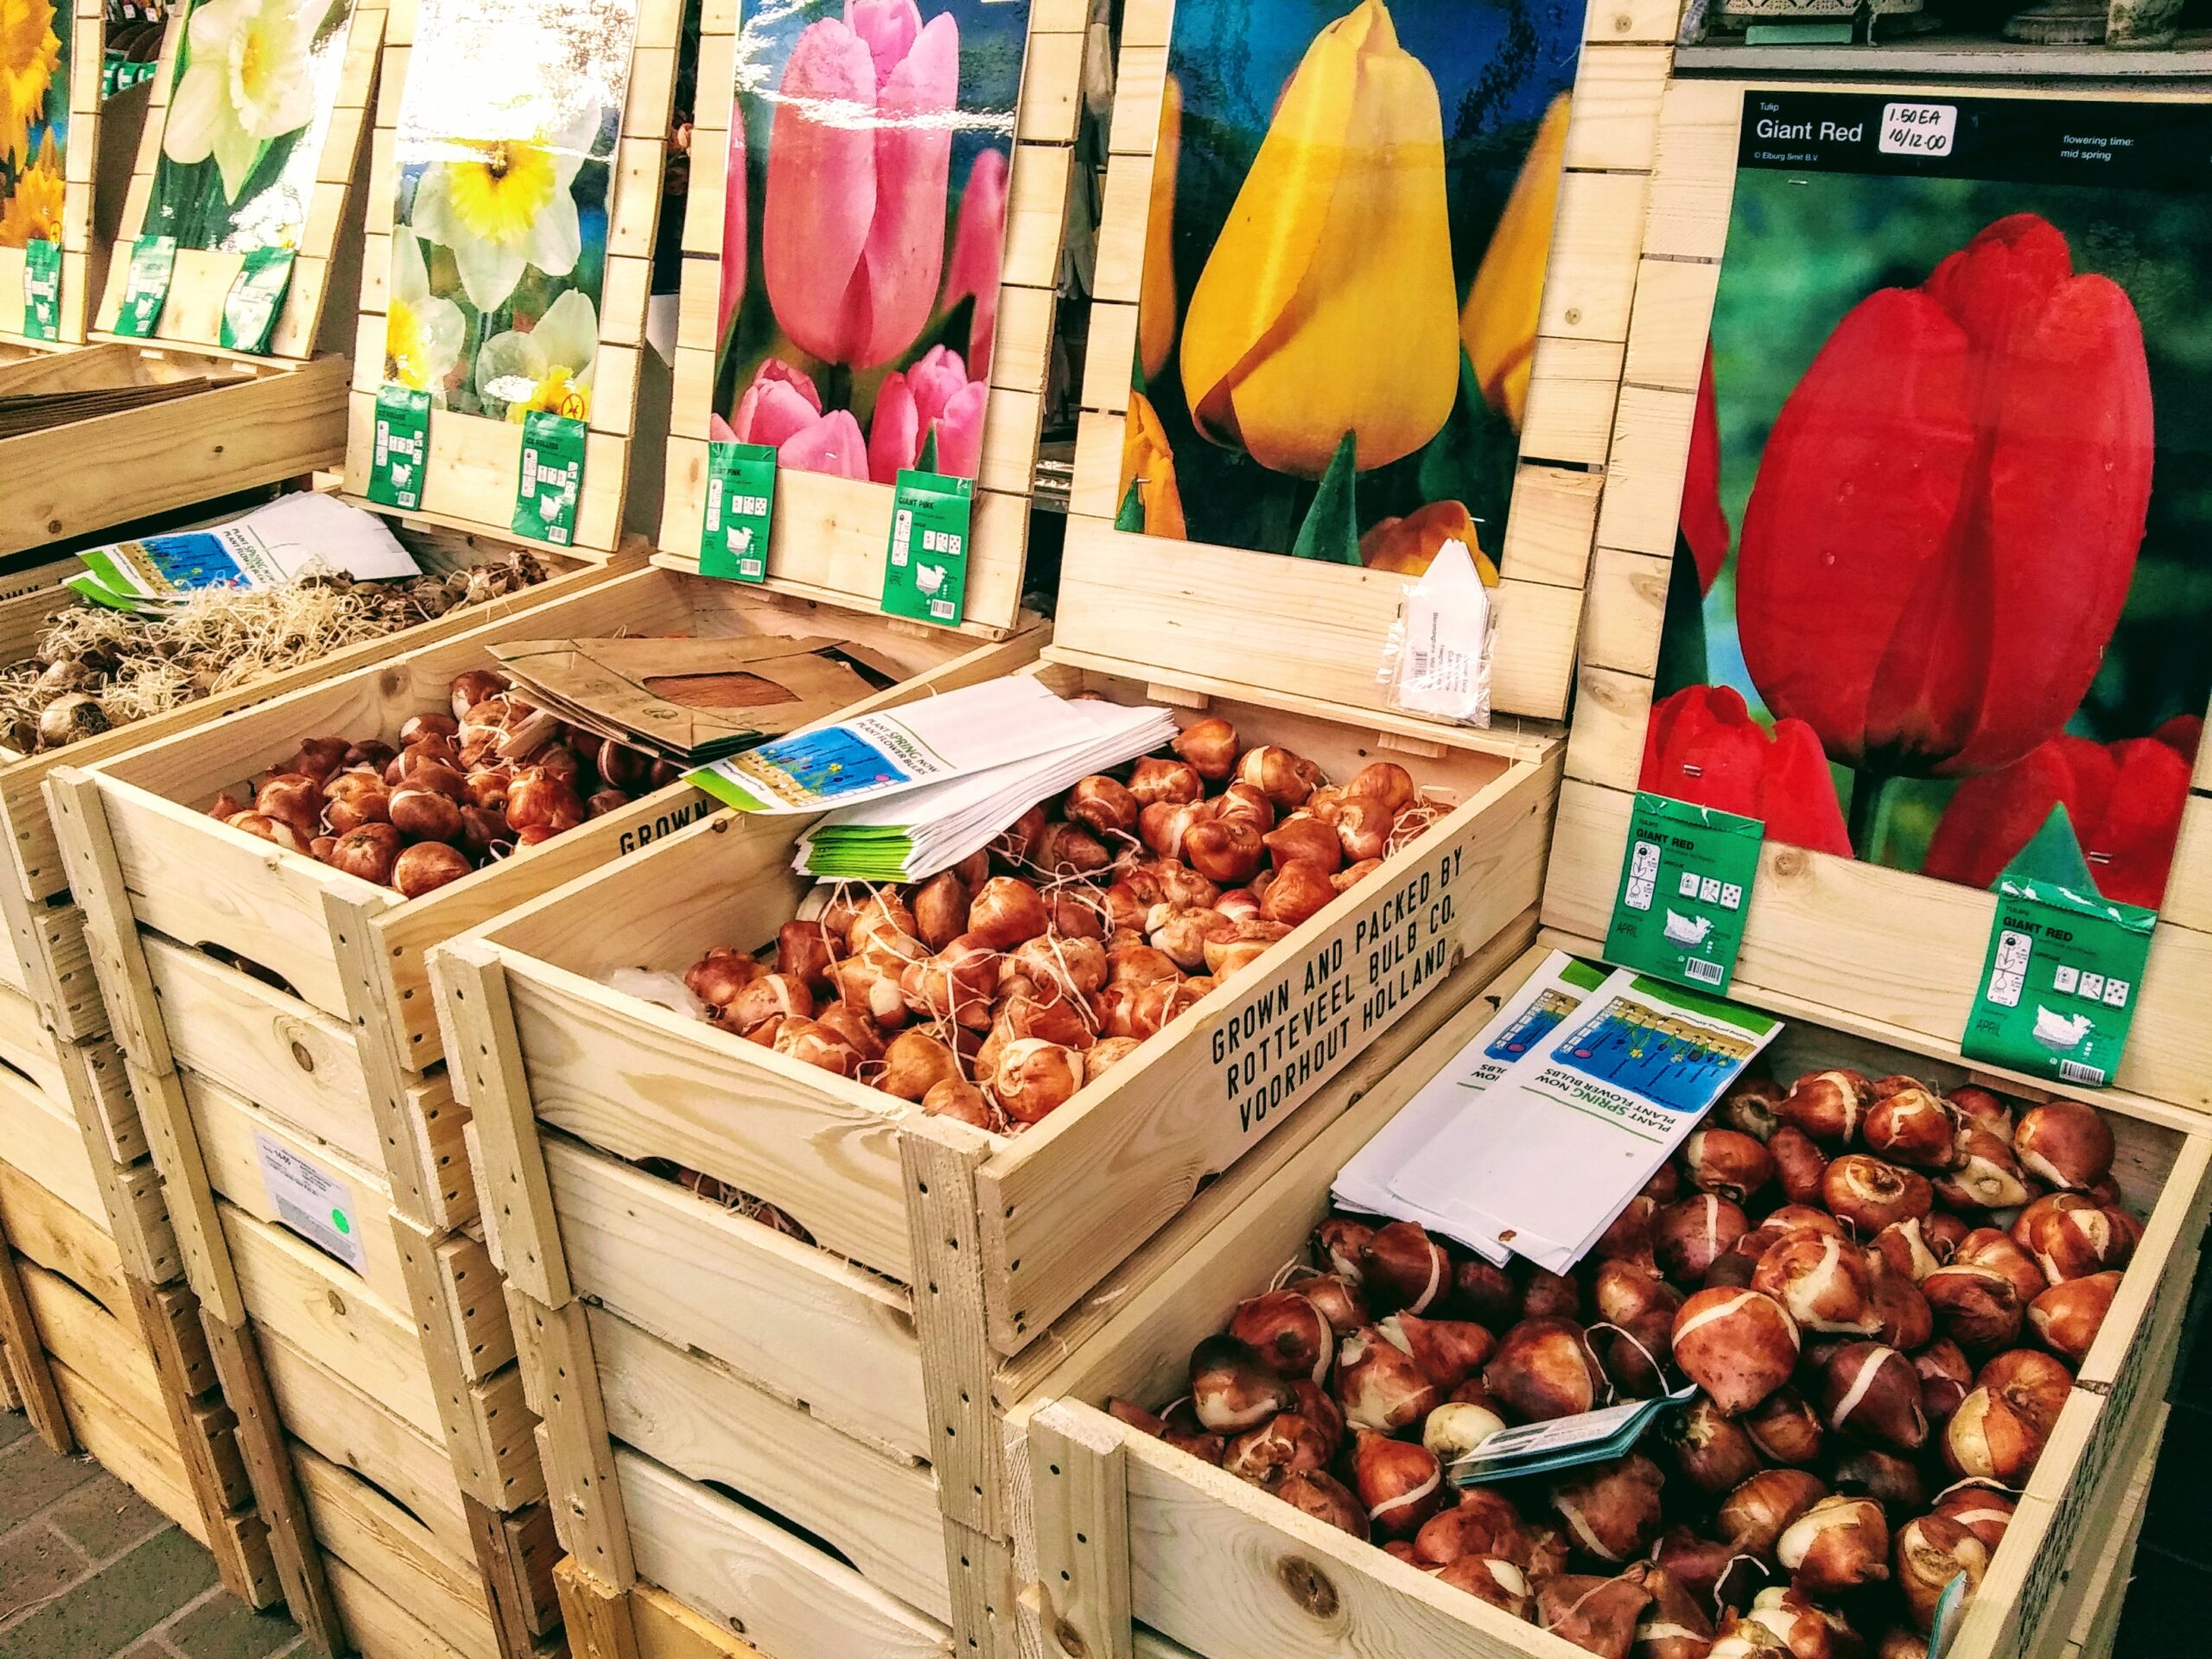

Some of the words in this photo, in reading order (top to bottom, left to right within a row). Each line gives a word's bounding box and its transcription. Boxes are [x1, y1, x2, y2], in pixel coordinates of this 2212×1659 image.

[1760, 102, 1779, 112] Tulip
[1918, 110, 1942, 125] EA
[1757, 119, 1813, 140] Giant
[1820, 122, 1863, 142] Red
[2063, 135, 2107, 147] flowering
[2109, 137, 2134, 146] time:
[2060, 149, 2079, 158] mid
[2081, 149, 2112, 162] spring
[855, 721, 881, 736] PLANT
[877, 735, 907, 759] FLOWER
[903, 759, 928, 775] BULBS
[866, 718, 891, 733] PLANT
[886, 731, 923, 759] SPRING
[918, 760, 940, 772] NOW
[619, 798, 709, 855] GROWN
[1636, 828, 1669, 843] GIANT
[1671, 836, 1694, 851] RED
[1617, 923, 1637, 938] APRIL
[2003, 917, 2042, 934] GIANT
[2045, 927, 2074, 943] RED
[1212, 979, 1289, 1065] GROWN
[1303, 938, 1343, 996] AND
[1356, 871, 1430, 954] PACKED
[1440, 845, 1463, 888] BY
[1227, 973, 1356, 1101] ROTTEVEEL
[1369, 921, 1417, 985] BULB
[1429, 894, 1456, 934] CO.
[1239, 1017, 1351, 1134] VOORHOUT
[1363, 938, 1446, 1033] HOLLAND
[1535, 1075, 1570, 1091] NOW
[1544, 1068, 1583, 1086] BULBS
[1570, 1087, 1630, 1116] SPRING
[1584, 1083, 1635, 1107] FLOWER
[1628, 1113, 1672, 1133] PLANT
[1633, 1105, 1676, 1125] PLANT
